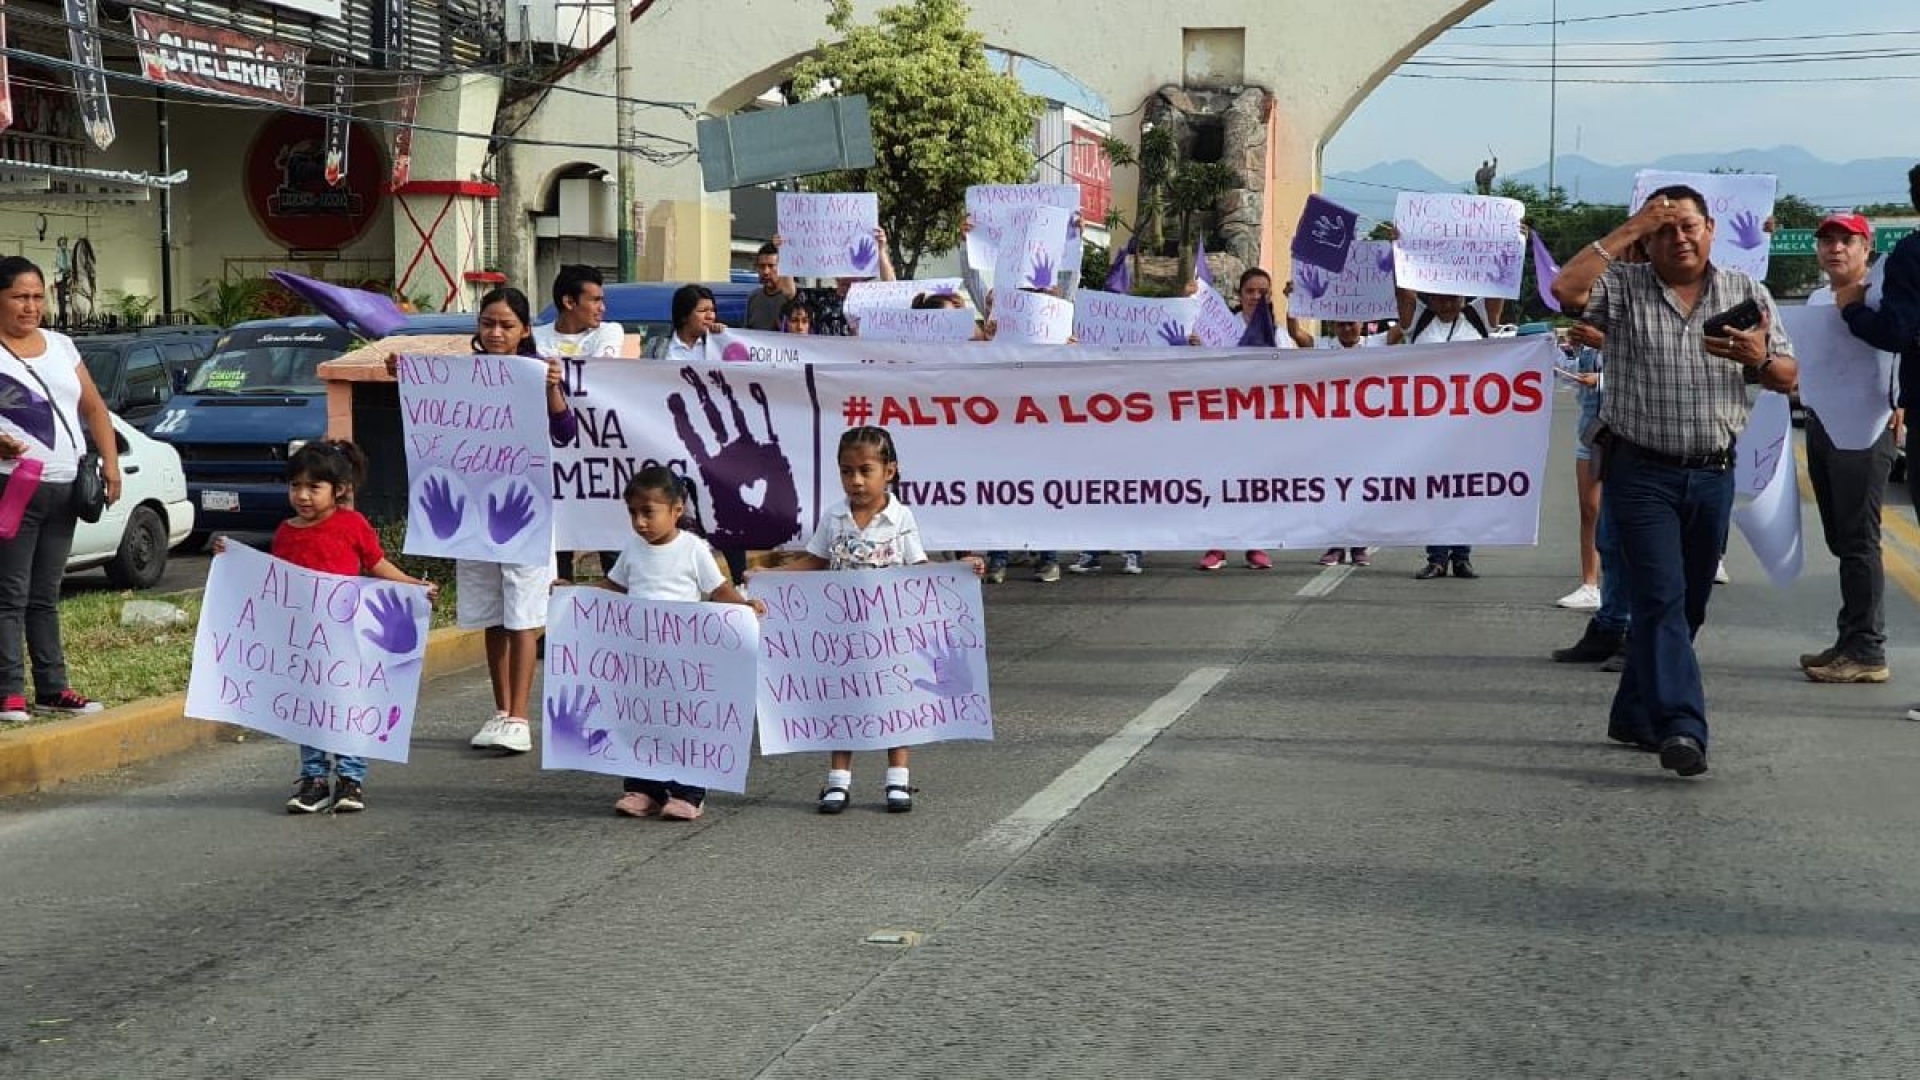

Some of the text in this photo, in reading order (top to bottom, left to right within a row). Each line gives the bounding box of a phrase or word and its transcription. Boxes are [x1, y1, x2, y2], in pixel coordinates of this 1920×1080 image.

[824, 195, 863, 217] AMA
[1089, 298, 1171, 326] BUSCAMOS
[1116, 326, 1151, 345] VIDA
[399, 357, 449, 385] ALTO
[749, 346, 800, 363] POR UNA
[403, 396, 515, 432] VIOLENCIA
[843, 371, 1544, 427] #ALTO A LOS FEMINICIDIOS
[552, 407, 628, 449] NA
[899, 471, 1531, 510] IVAS NOS QUEREMOS, LIBRES Y SIN MIEDO
[261, 561, 361, 623] ALTO
[762, 575, 969, 625] NO SUMISAS,
[237, 597, 331, 655] A LA
[572, 595, 743, 652] MARCHAMOS
[764, 613, 984, 667] NI OBEDIENTES.
[213, 632, 389, 692] VIOLENCIA
[551, 641, 718, 693] EN CONTRA DE
[764, 656, 950, 705] VALIENTES E
[220, 675, 401, 742] DE GENERO!
[613, 690, 743, 734] VIOLENCIA
[782, 693, 989, 743] INDEPENDIENTES
[633, 735, 736, 775] GENERO
